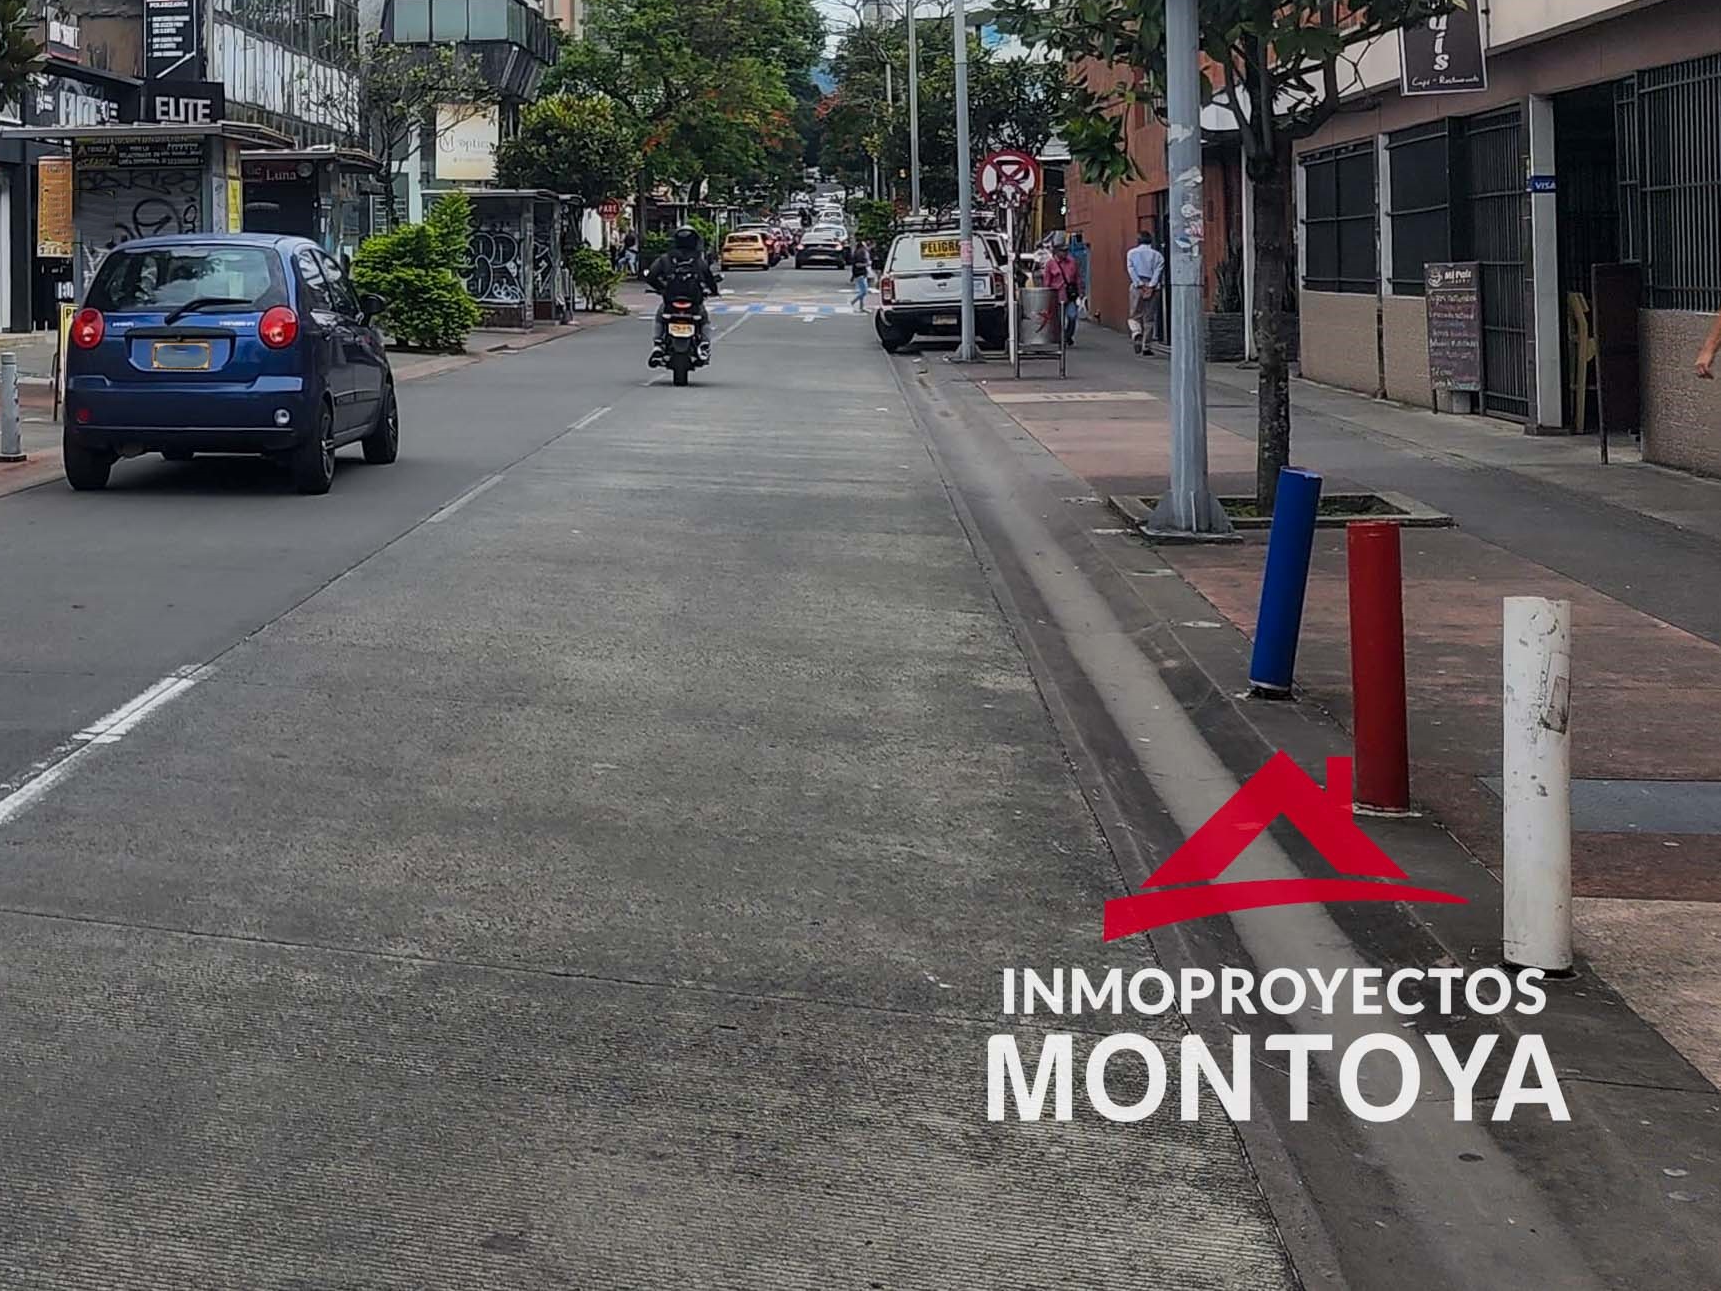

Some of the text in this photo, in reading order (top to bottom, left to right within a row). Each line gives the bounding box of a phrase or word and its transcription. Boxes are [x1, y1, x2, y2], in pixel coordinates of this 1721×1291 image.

[155, 96, 212, 125] ELITE
[265, 169, 297, 181] Luna
[1535, 181, 1556, 189] VISA
